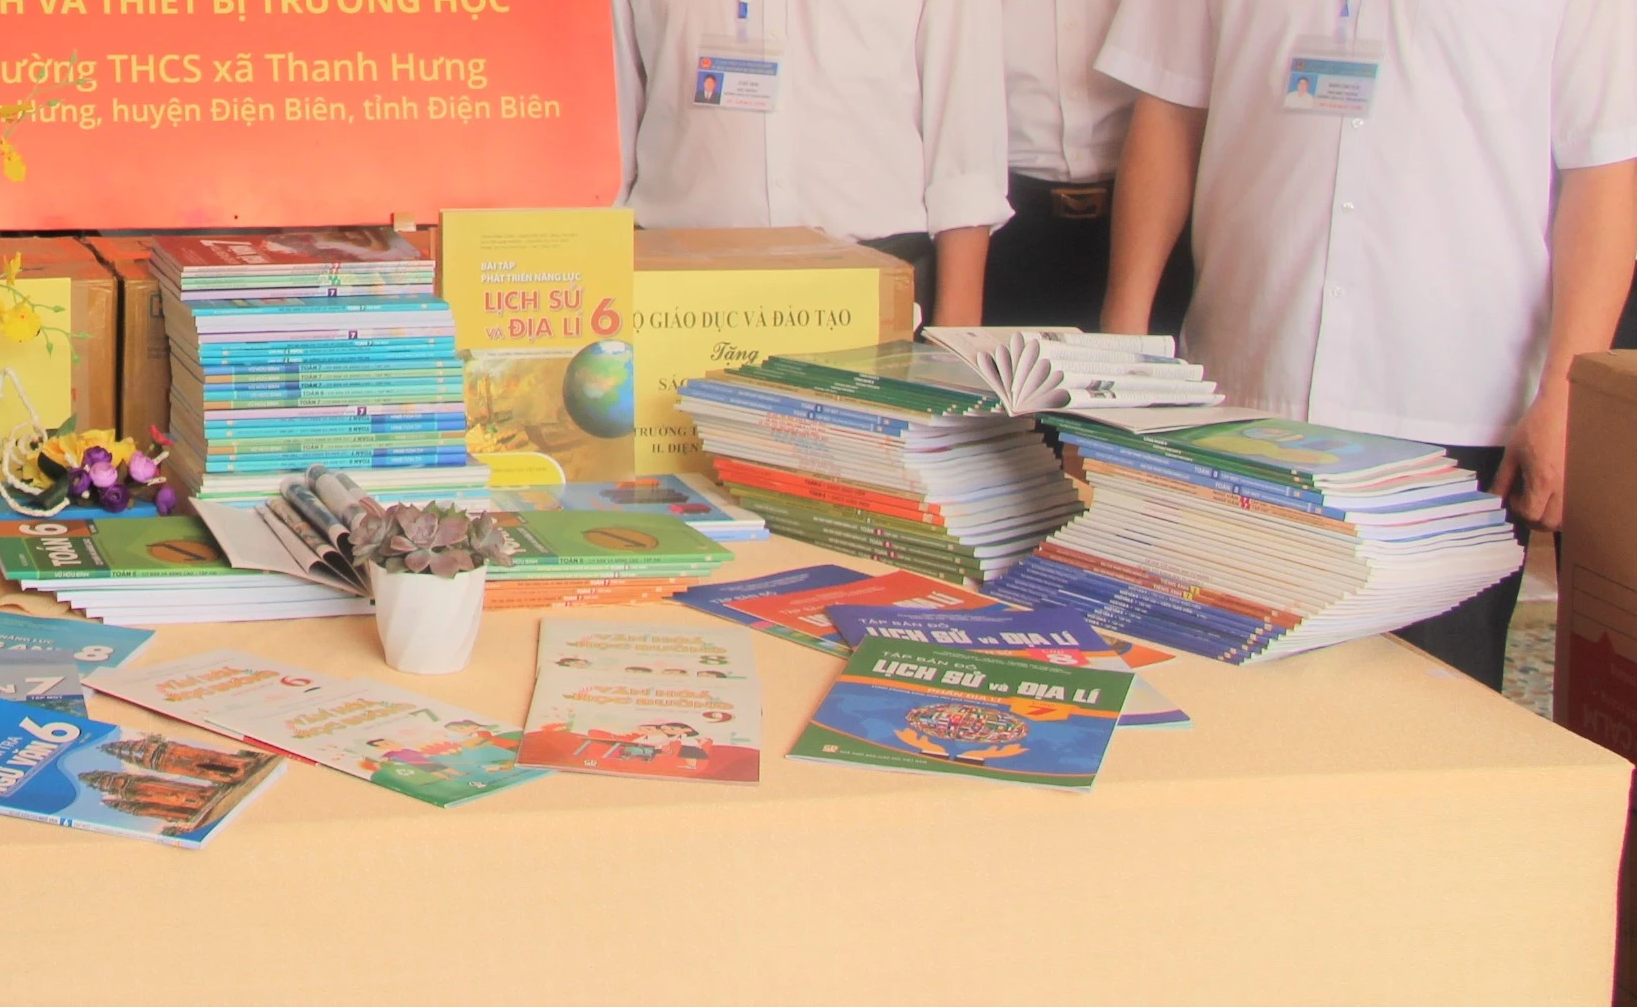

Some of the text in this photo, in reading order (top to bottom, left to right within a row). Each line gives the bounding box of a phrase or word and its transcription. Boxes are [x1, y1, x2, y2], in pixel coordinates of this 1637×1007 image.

[107, 54, 202, 83] THCS
[214, 53, 253, 83] xã
[265, 52, 377, 82] Thanh
[392, 53, 487, 89] Hưng
[18, 100, 102, 130] Hưng,
[113, 98, 200, 129] huyện
[211, 97, 274, 126] Điện
[285, 97, 353, 123] Biên,
[364, 96, 418, 120] tỉnh
[428, 97, 490, 120] Điện
[501, 96, 559, 118] Biên
[484, 282, 584, 316] LỊCH SỬ
[508, 316, 553, 342] ĐỊA
[562, 311, 583, 336] LÍ
[590, 296, 622, 337] 6
[649, 305, 697, 328] GIÁO
[702, 310, 740, 333] DỤC
[744, 305, 767, 328] VÀ
[771, 304, 811, 328] ĐÀO
[814, 309, 852, 331] TẠO
[710, 341, 760, 367] Tặng
[18, 523, 82, 567] TOÁN 6
[931, 627, 974, 645] SỬ
[979, 635, 1001, 645] và
[1000, 631, 1052, 647] ĐỊA
[1050, 629, 1080, 647] LÍ
[74, 645, 114, 662] 8
[698, 655, 730, 666] 8
[1046, 653, 1079, 666] 8
[25, 676, 66, 695] 7
[280, 675, 312, 687] 6
[872, 659, 938, 680] LỊCH
[940, 668, 987, 689] SỬ
[988, 682, 1010, 693] và
[1017, 680, 1065, 702] ĐỊA
[1072, 687, 1101, 705] LÍ
[701, 711, 734, 724] 9
[1027, 705, 1057, 716] 7
[19, 716, 82, 744] 6
[2, 735, 24, 756] TRA
[12, 740, 61, 775] VĂN
